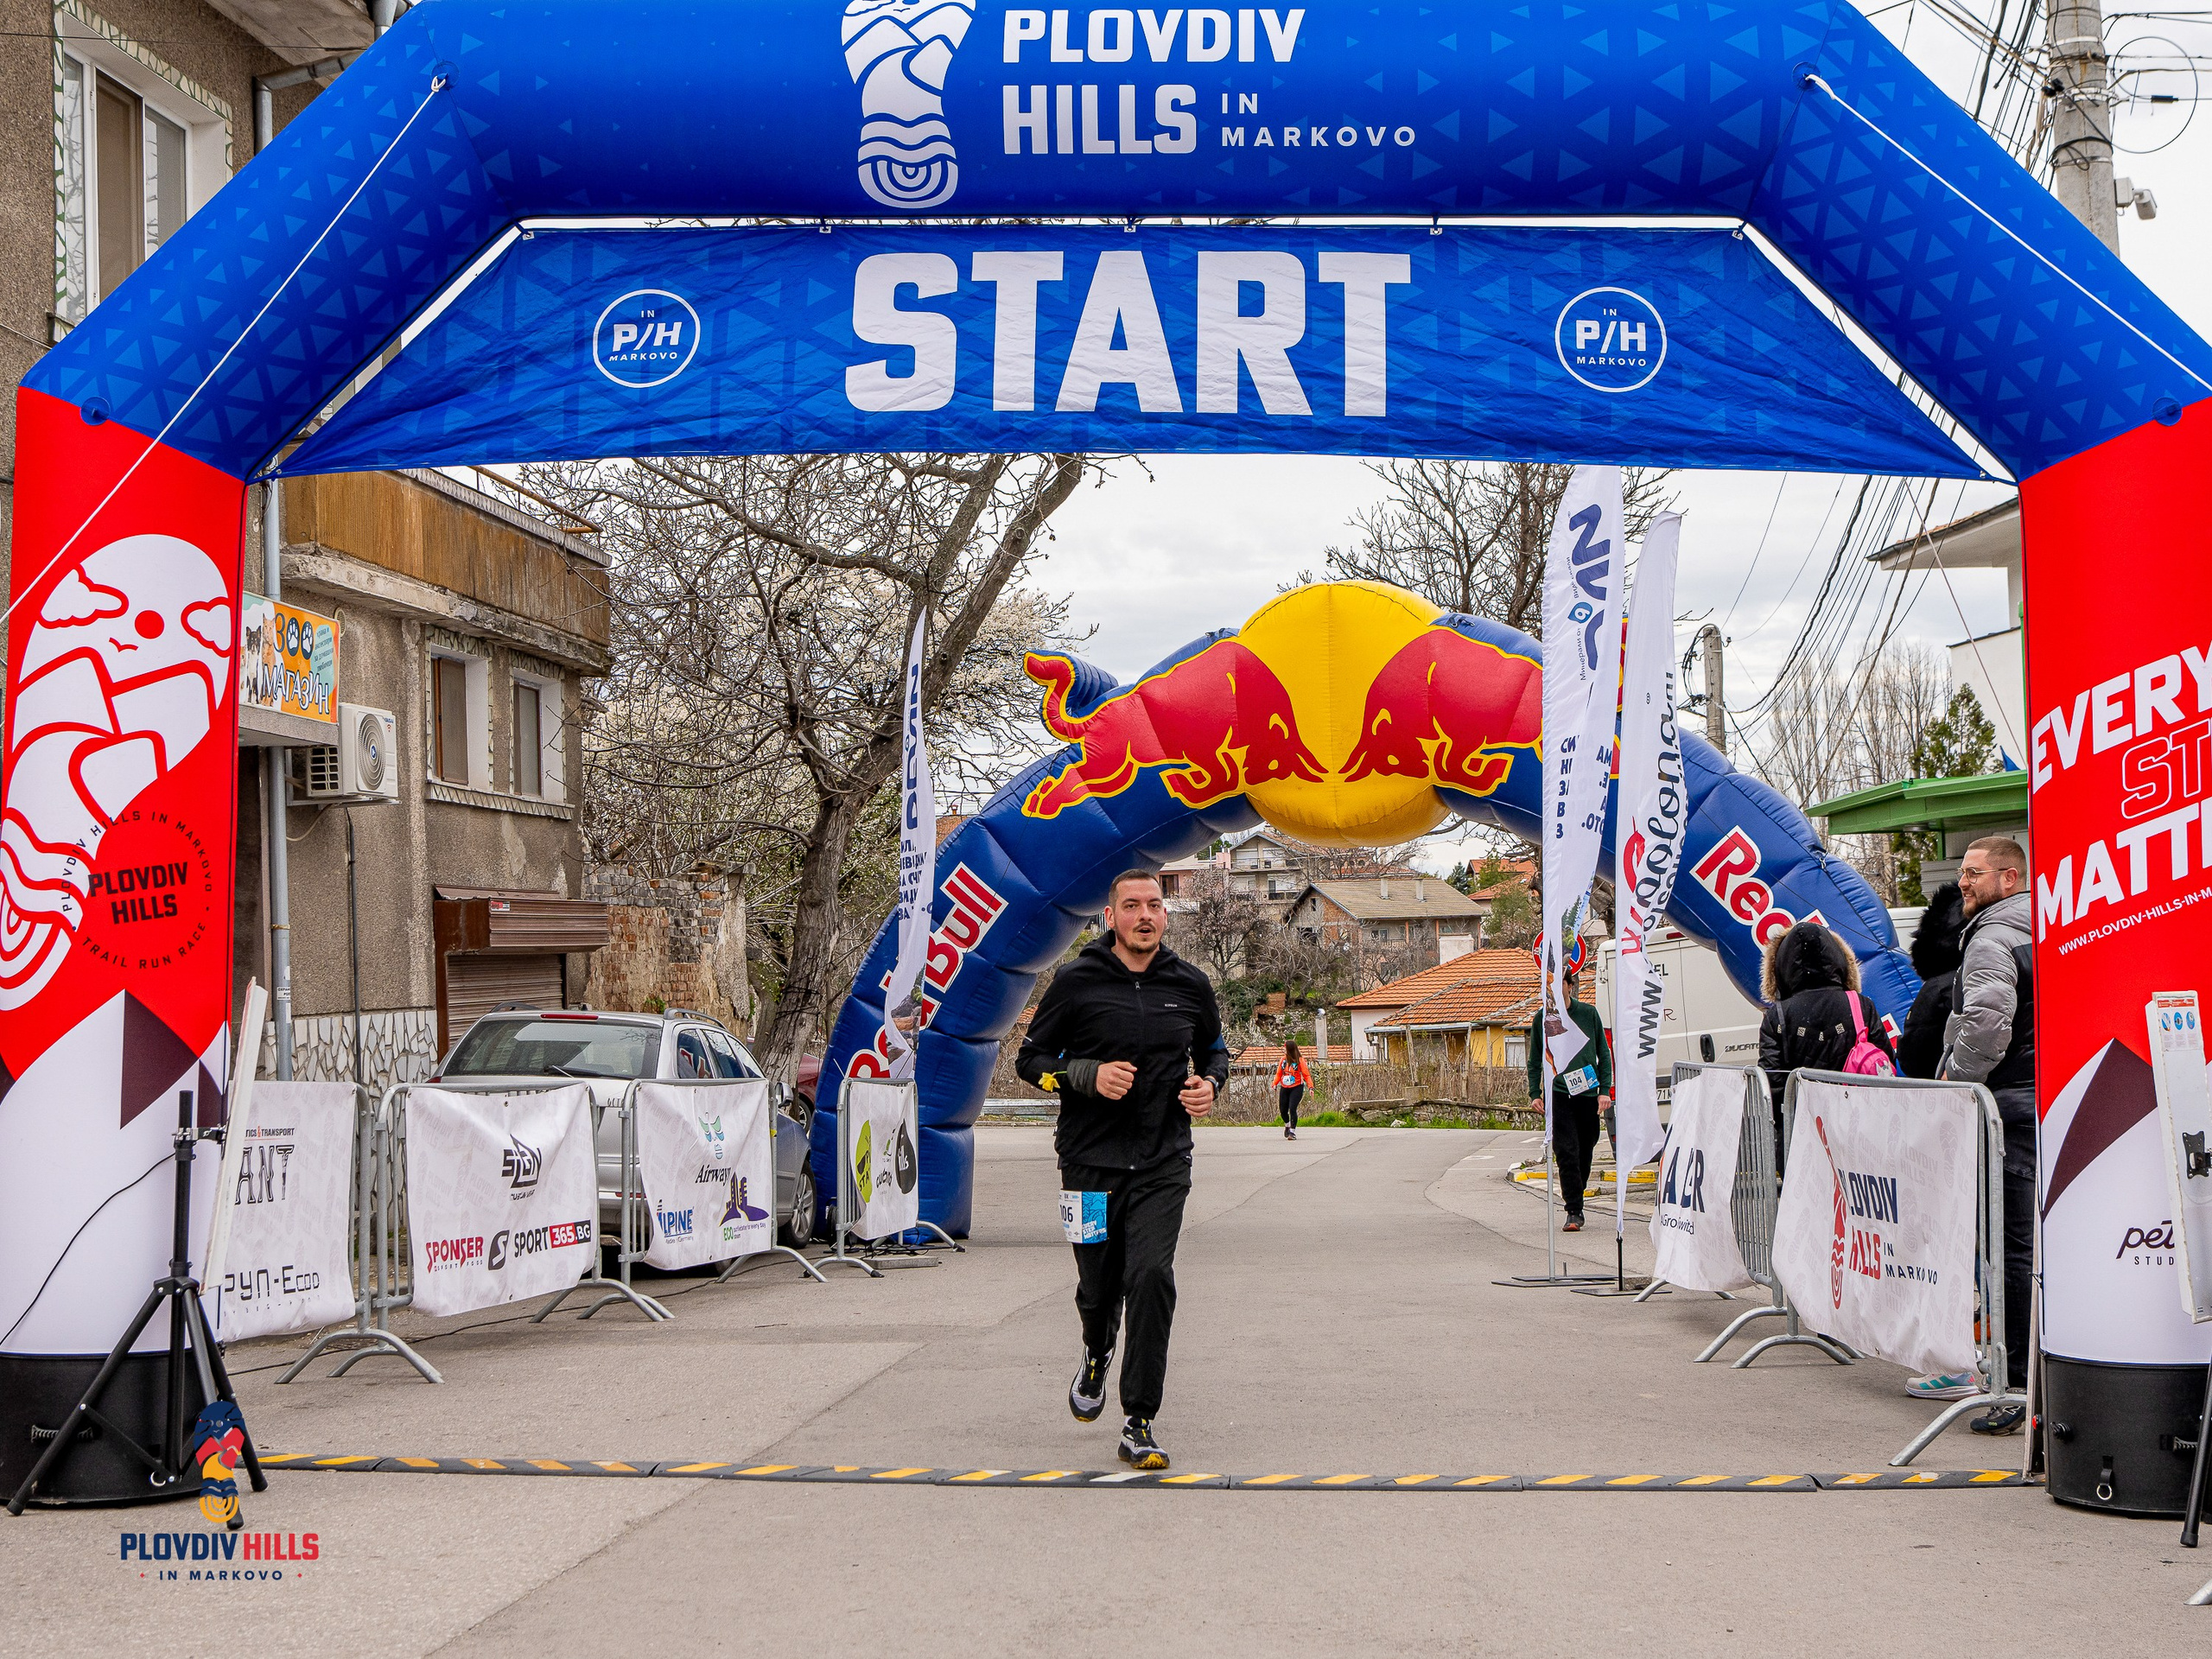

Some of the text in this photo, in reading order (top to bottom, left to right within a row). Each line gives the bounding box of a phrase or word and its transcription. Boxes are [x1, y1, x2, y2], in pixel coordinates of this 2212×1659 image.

[1003, 8, 1306, 63] PLOVDIV
[1003, 84, 1197, 156] HILLS
[1221, 93, 1258, 114] IN
[1221, 126, 1417, 148] MARKOVO
[640, 309, 655, 318] IN
[612, 321, 683, 352] P/H
[845, 250, 1411, 418] START
[1575, 319, 1647, 354] P/H
[608, 352, 678, 362] MARKOVO
[1576, 356, 1647, 367] MARKOVO
[262, 662, 330, 715] МАГАЗИН
[2120, 717, 2212, 819] ST
[61, 810, 213, 912] PLOVDIV HILLS IN MARKOVO
[2036, 796, 2212, 944] MATT
[88, 861, 188, 898] PLOVDIV
[111, 893, 178, 925] HILLS
[81, 922, 206, 969] TRAIL RUN RACE
[1568, 1076, 1582, 1087] 104
[261, 1128, 295, 1137] TRANSPORT
[1838, 1167, 1898, 1224] POVDIV
[425, 1236, 484, 1274] SPONSER
[1884, 1242, 1895, 1257] IN
[2134, 1255, 2175, 1266] STUD
[1885, 1263, 1938, 1285] MARKOVO
